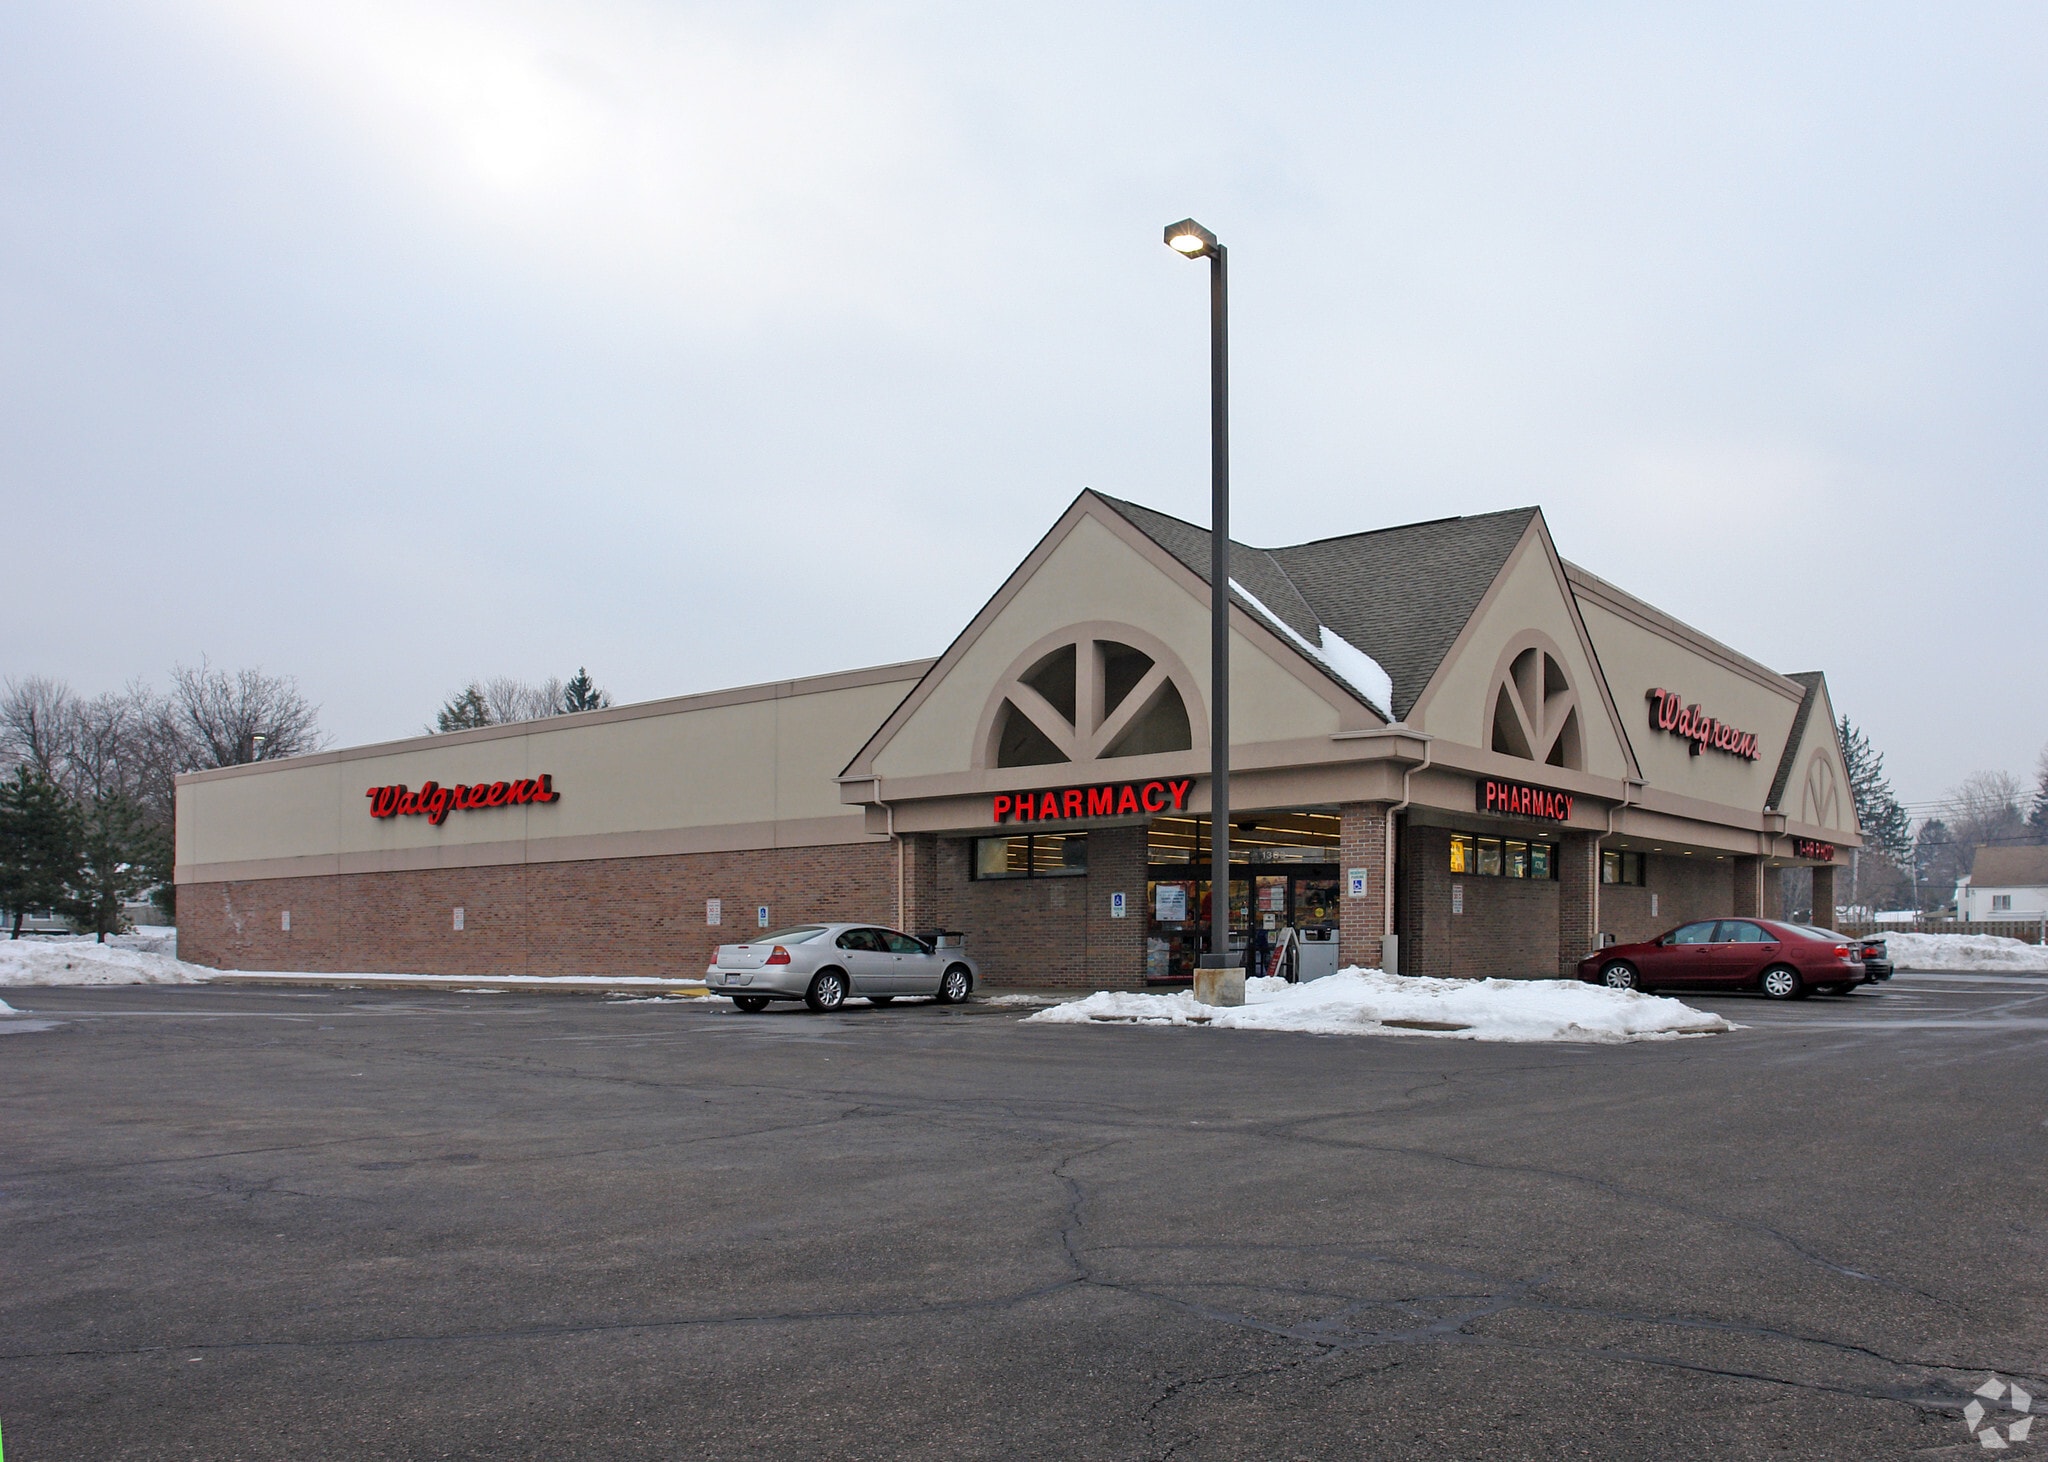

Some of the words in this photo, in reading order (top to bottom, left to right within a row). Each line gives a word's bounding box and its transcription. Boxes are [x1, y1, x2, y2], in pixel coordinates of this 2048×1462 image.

[1655, 687, 1761, 760] Walgreens
[366, 773, 556, 825] Walgreens
[993, 779, 1190, 823] PHARMACY
[1485, 780, 1574, 821] PHARMACY
